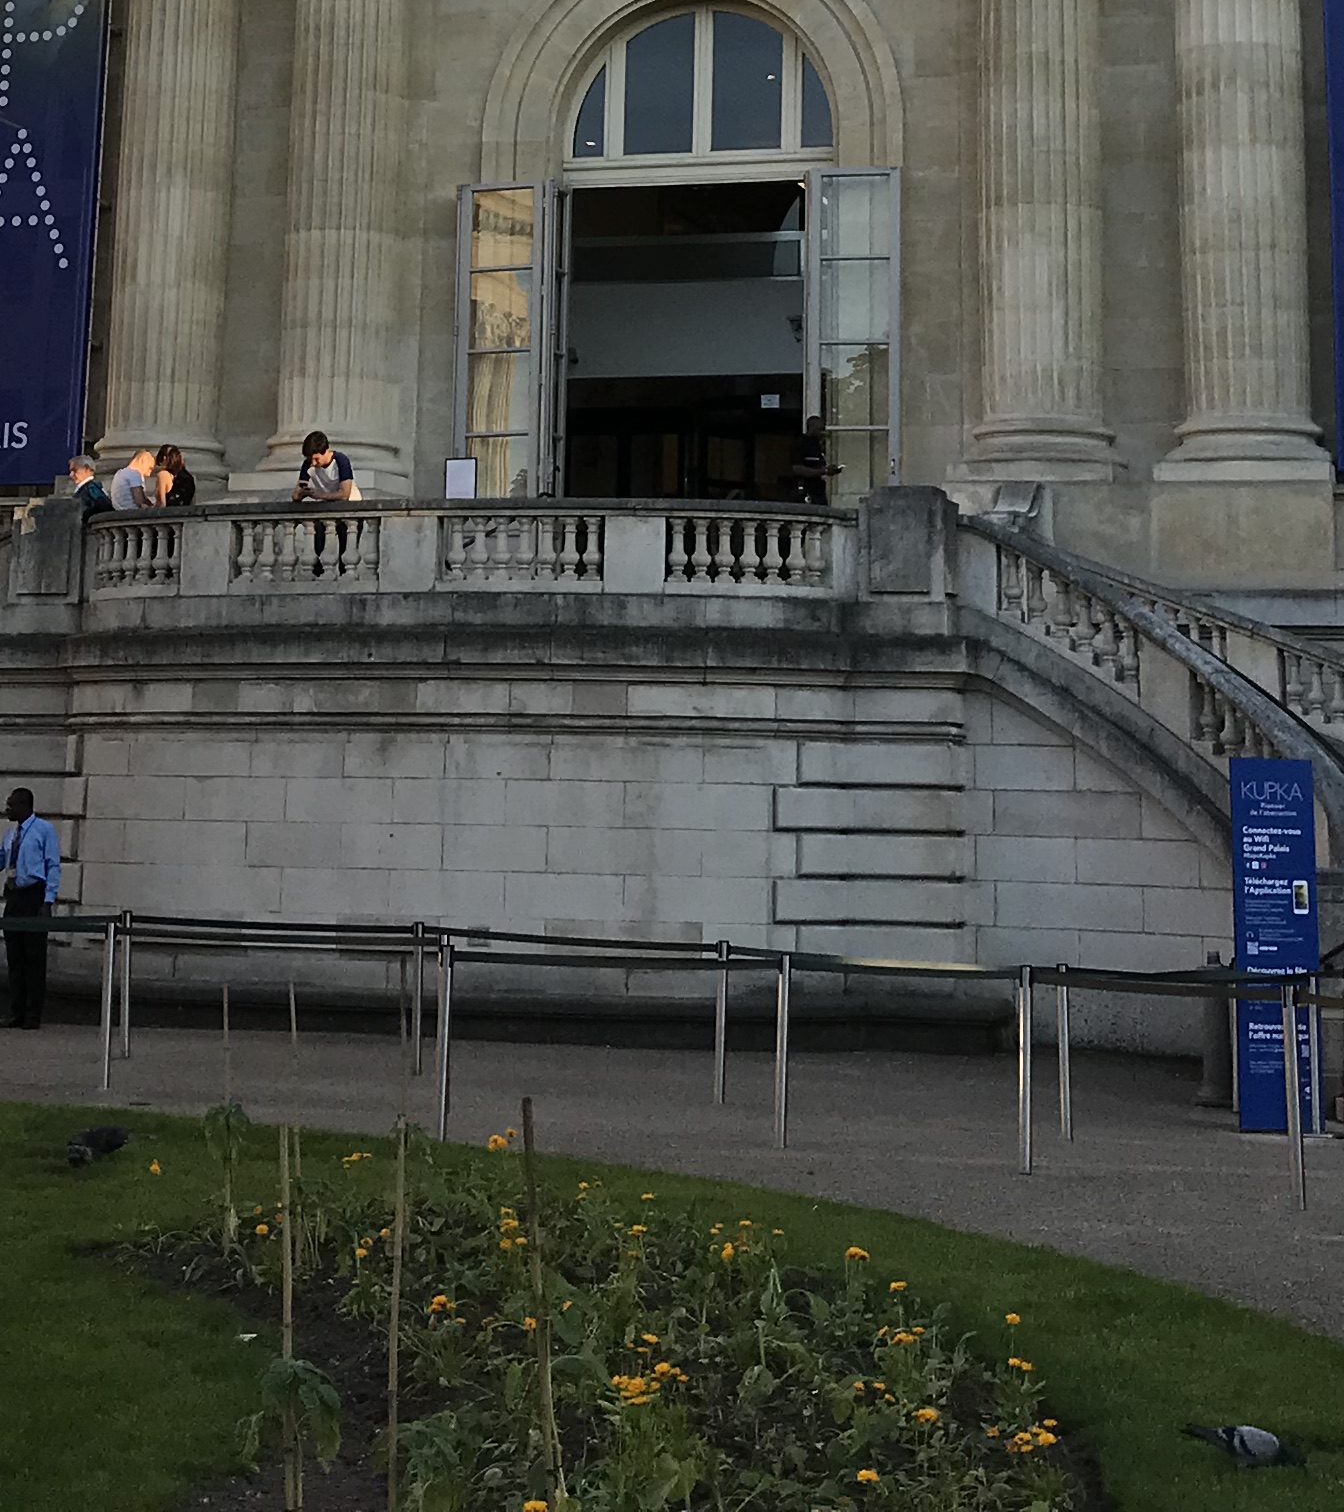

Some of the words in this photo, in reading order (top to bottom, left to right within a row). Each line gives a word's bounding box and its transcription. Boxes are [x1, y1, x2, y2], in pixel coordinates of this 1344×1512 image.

[1240, 781, 1304, 801] KUPKA
[1243, 843, 1266, 852] Grand
[1268, 844, 1290, 852] Palais
